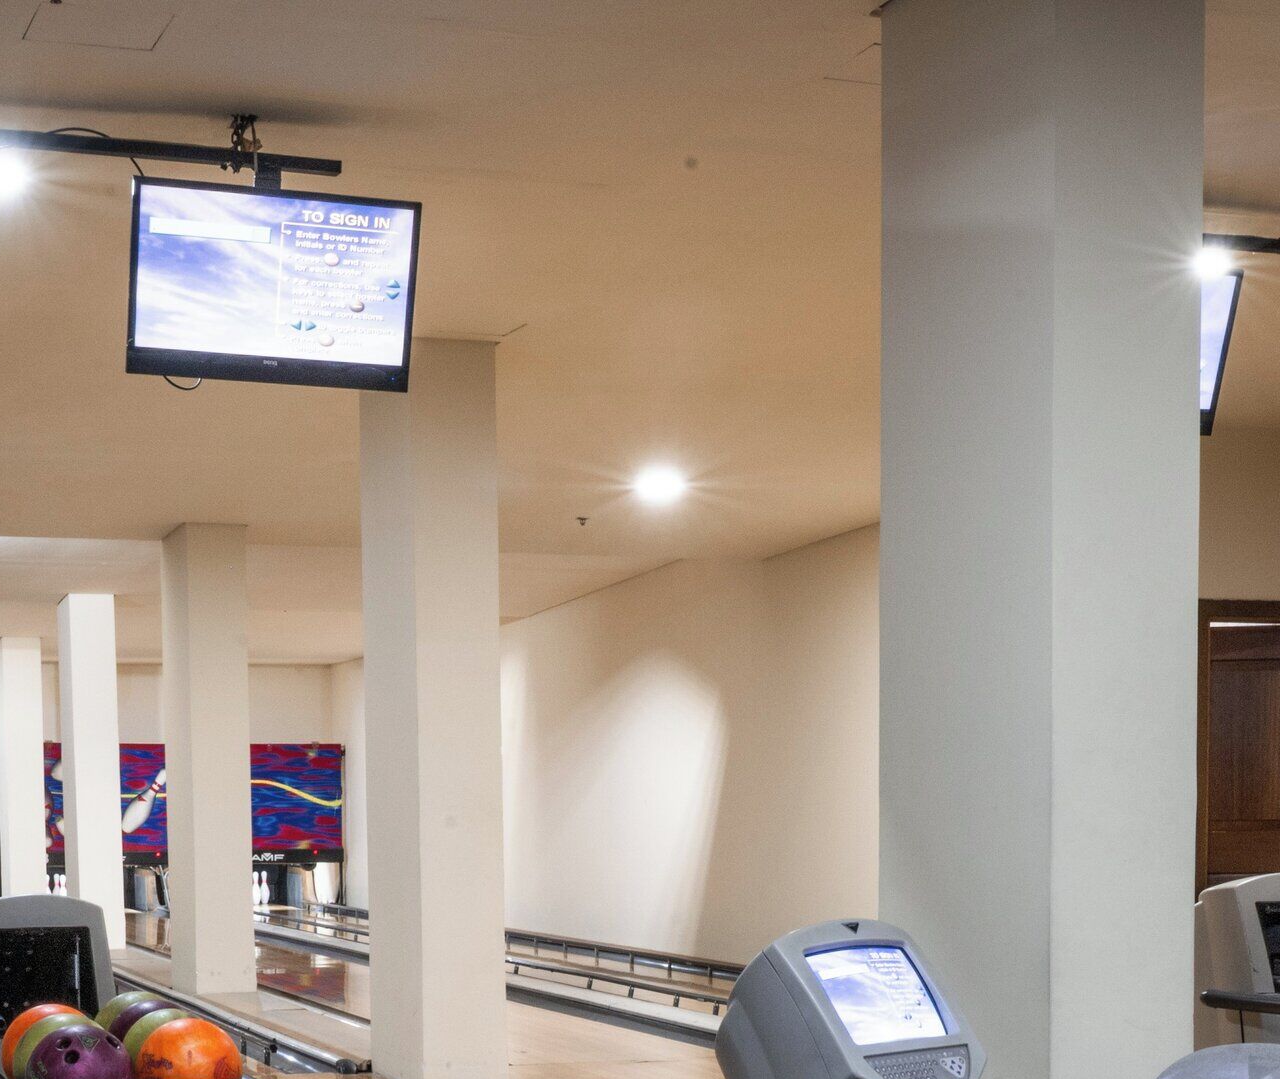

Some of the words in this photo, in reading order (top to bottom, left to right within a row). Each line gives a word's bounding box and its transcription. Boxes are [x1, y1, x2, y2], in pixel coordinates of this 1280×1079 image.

[302, 210, 324, 223] TO
[330, 213, 368, 227] SIGN
[374, 217, 390, 229] IN
[296, 230, 320, 239] Enter
[322, 233, 359, 243] Bowlers
[251, 853, 285, 861] AMF
